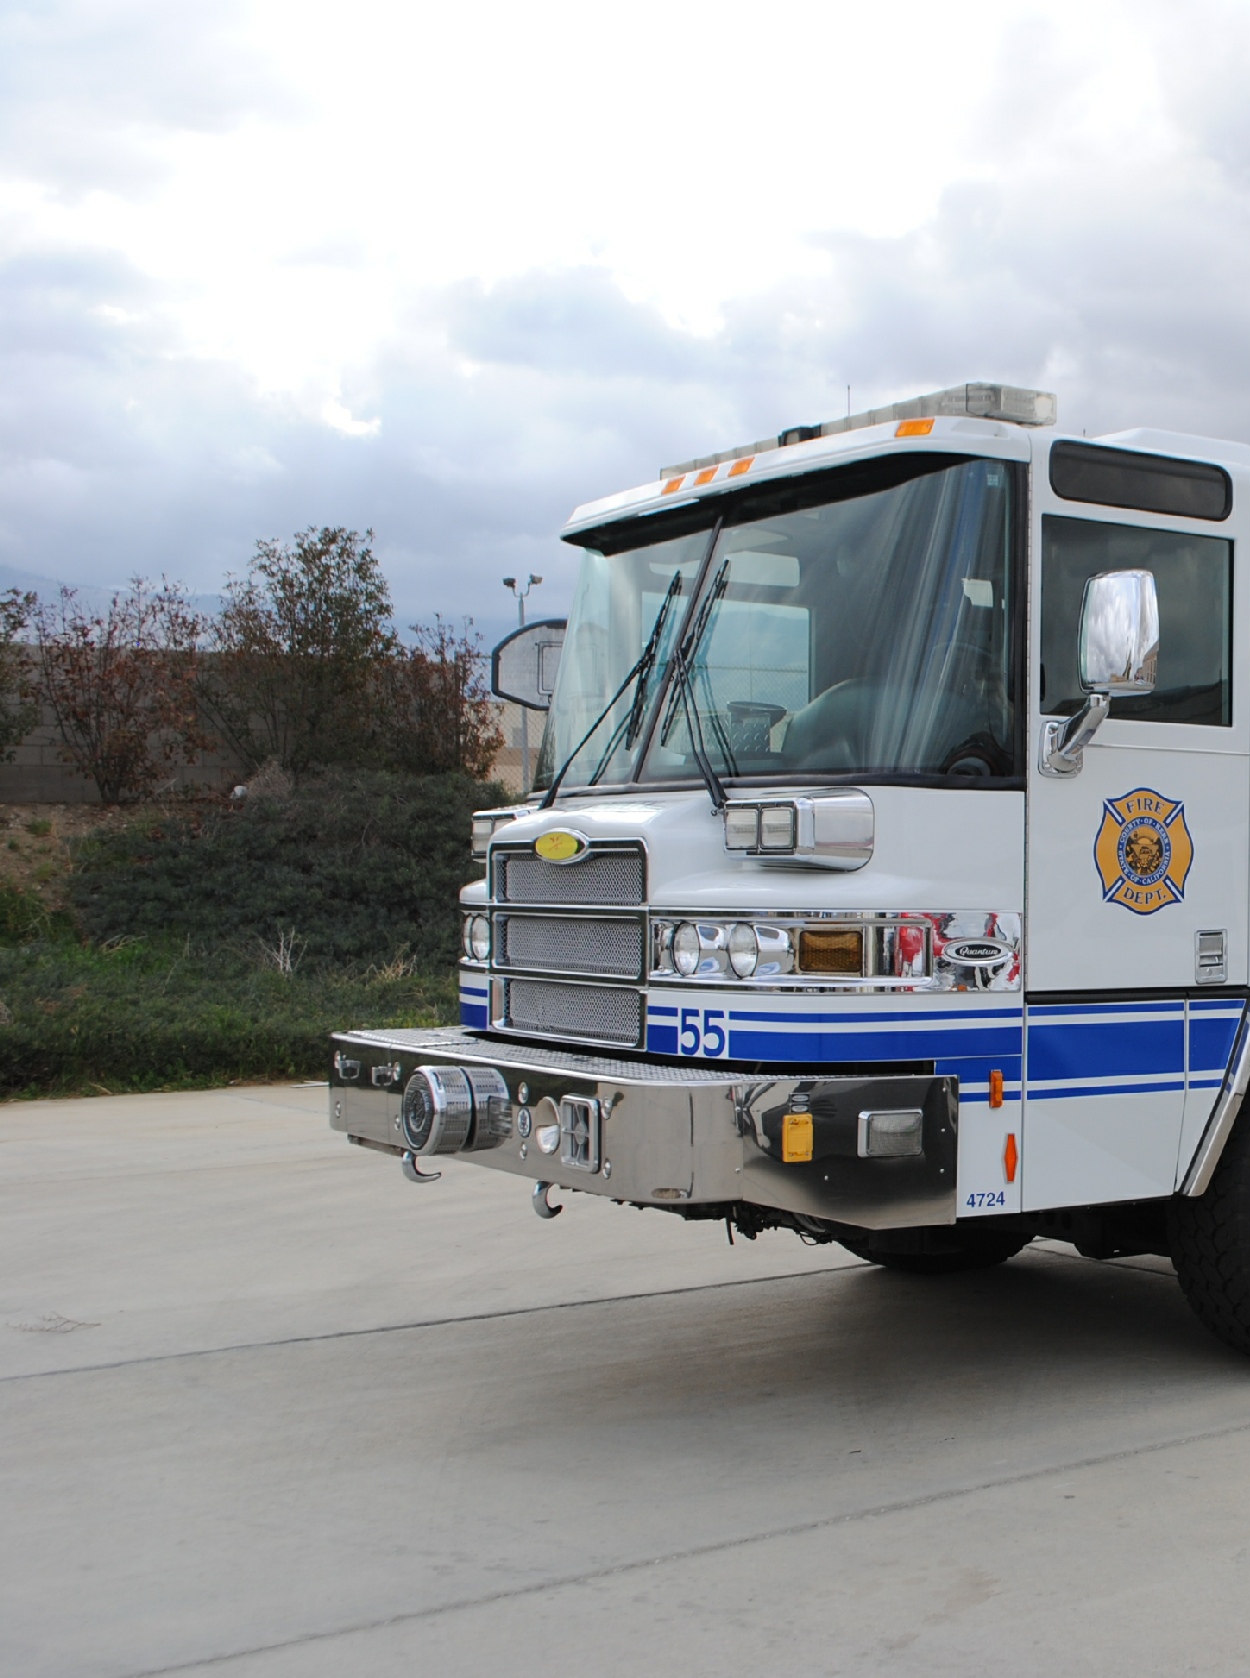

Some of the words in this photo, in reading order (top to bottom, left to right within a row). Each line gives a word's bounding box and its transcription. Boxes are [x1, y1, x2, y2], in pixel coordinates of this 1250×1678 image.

[1126, 798, 1165, 815] FIRE
[1119, 818, 1141, 843] COUNTY
[1123, 887, 1166, 905] DEPT.
[960, 946, 998, 957] Quantum
[681, 1008, 726, 1057] 55
[966, 1191, 1006, 1207] 4724
